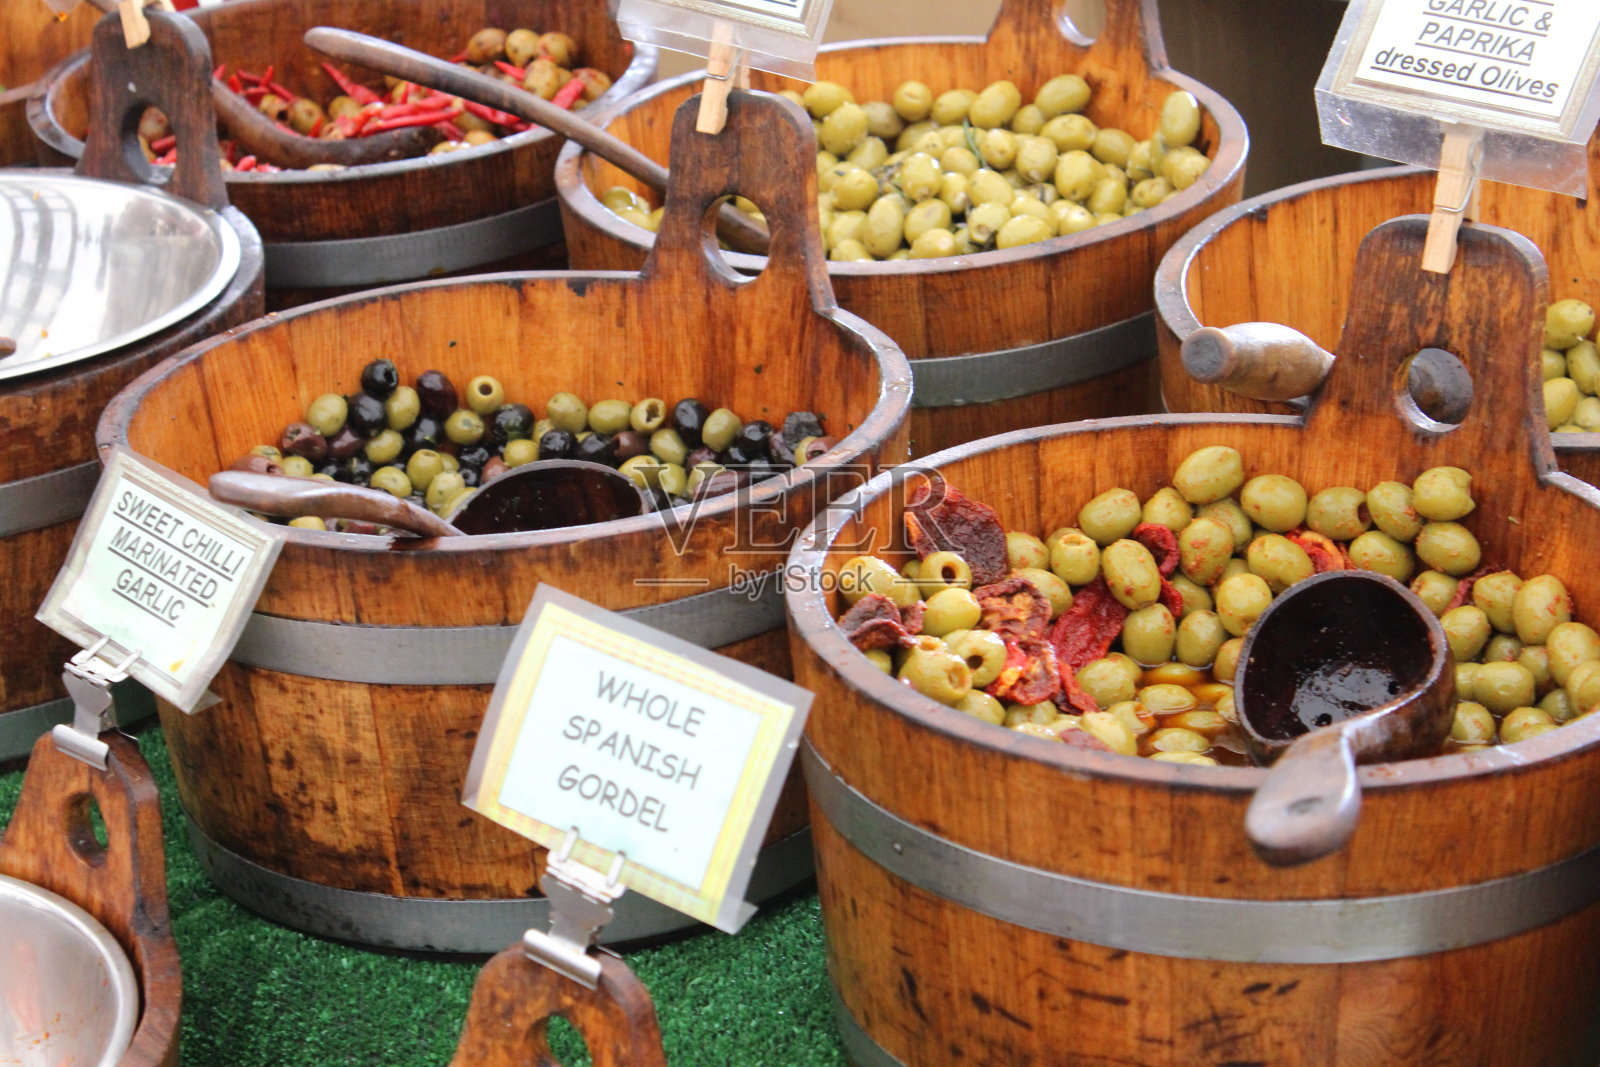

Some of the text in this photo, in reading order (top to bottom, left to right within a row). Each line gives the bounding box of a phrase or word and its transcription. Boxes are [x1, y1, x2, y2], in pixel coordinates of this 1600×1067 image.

[1418, 21, 1536, 61] PAPRIKA
[1428, 0, 1553, 32] GARLIC &
[1374, 47, 1560, 98] dressed Olives
[110, 526, 219, 601] MARINATED
[117, 490, 245, 576] SWEET CHILLI
[116, 568, 185, 621] GARLIC
[597, 670, 706, 738] WHOLE
[562, 715, 702, 790] SPANISH
[557, 765, 669, 833] GORDEL
